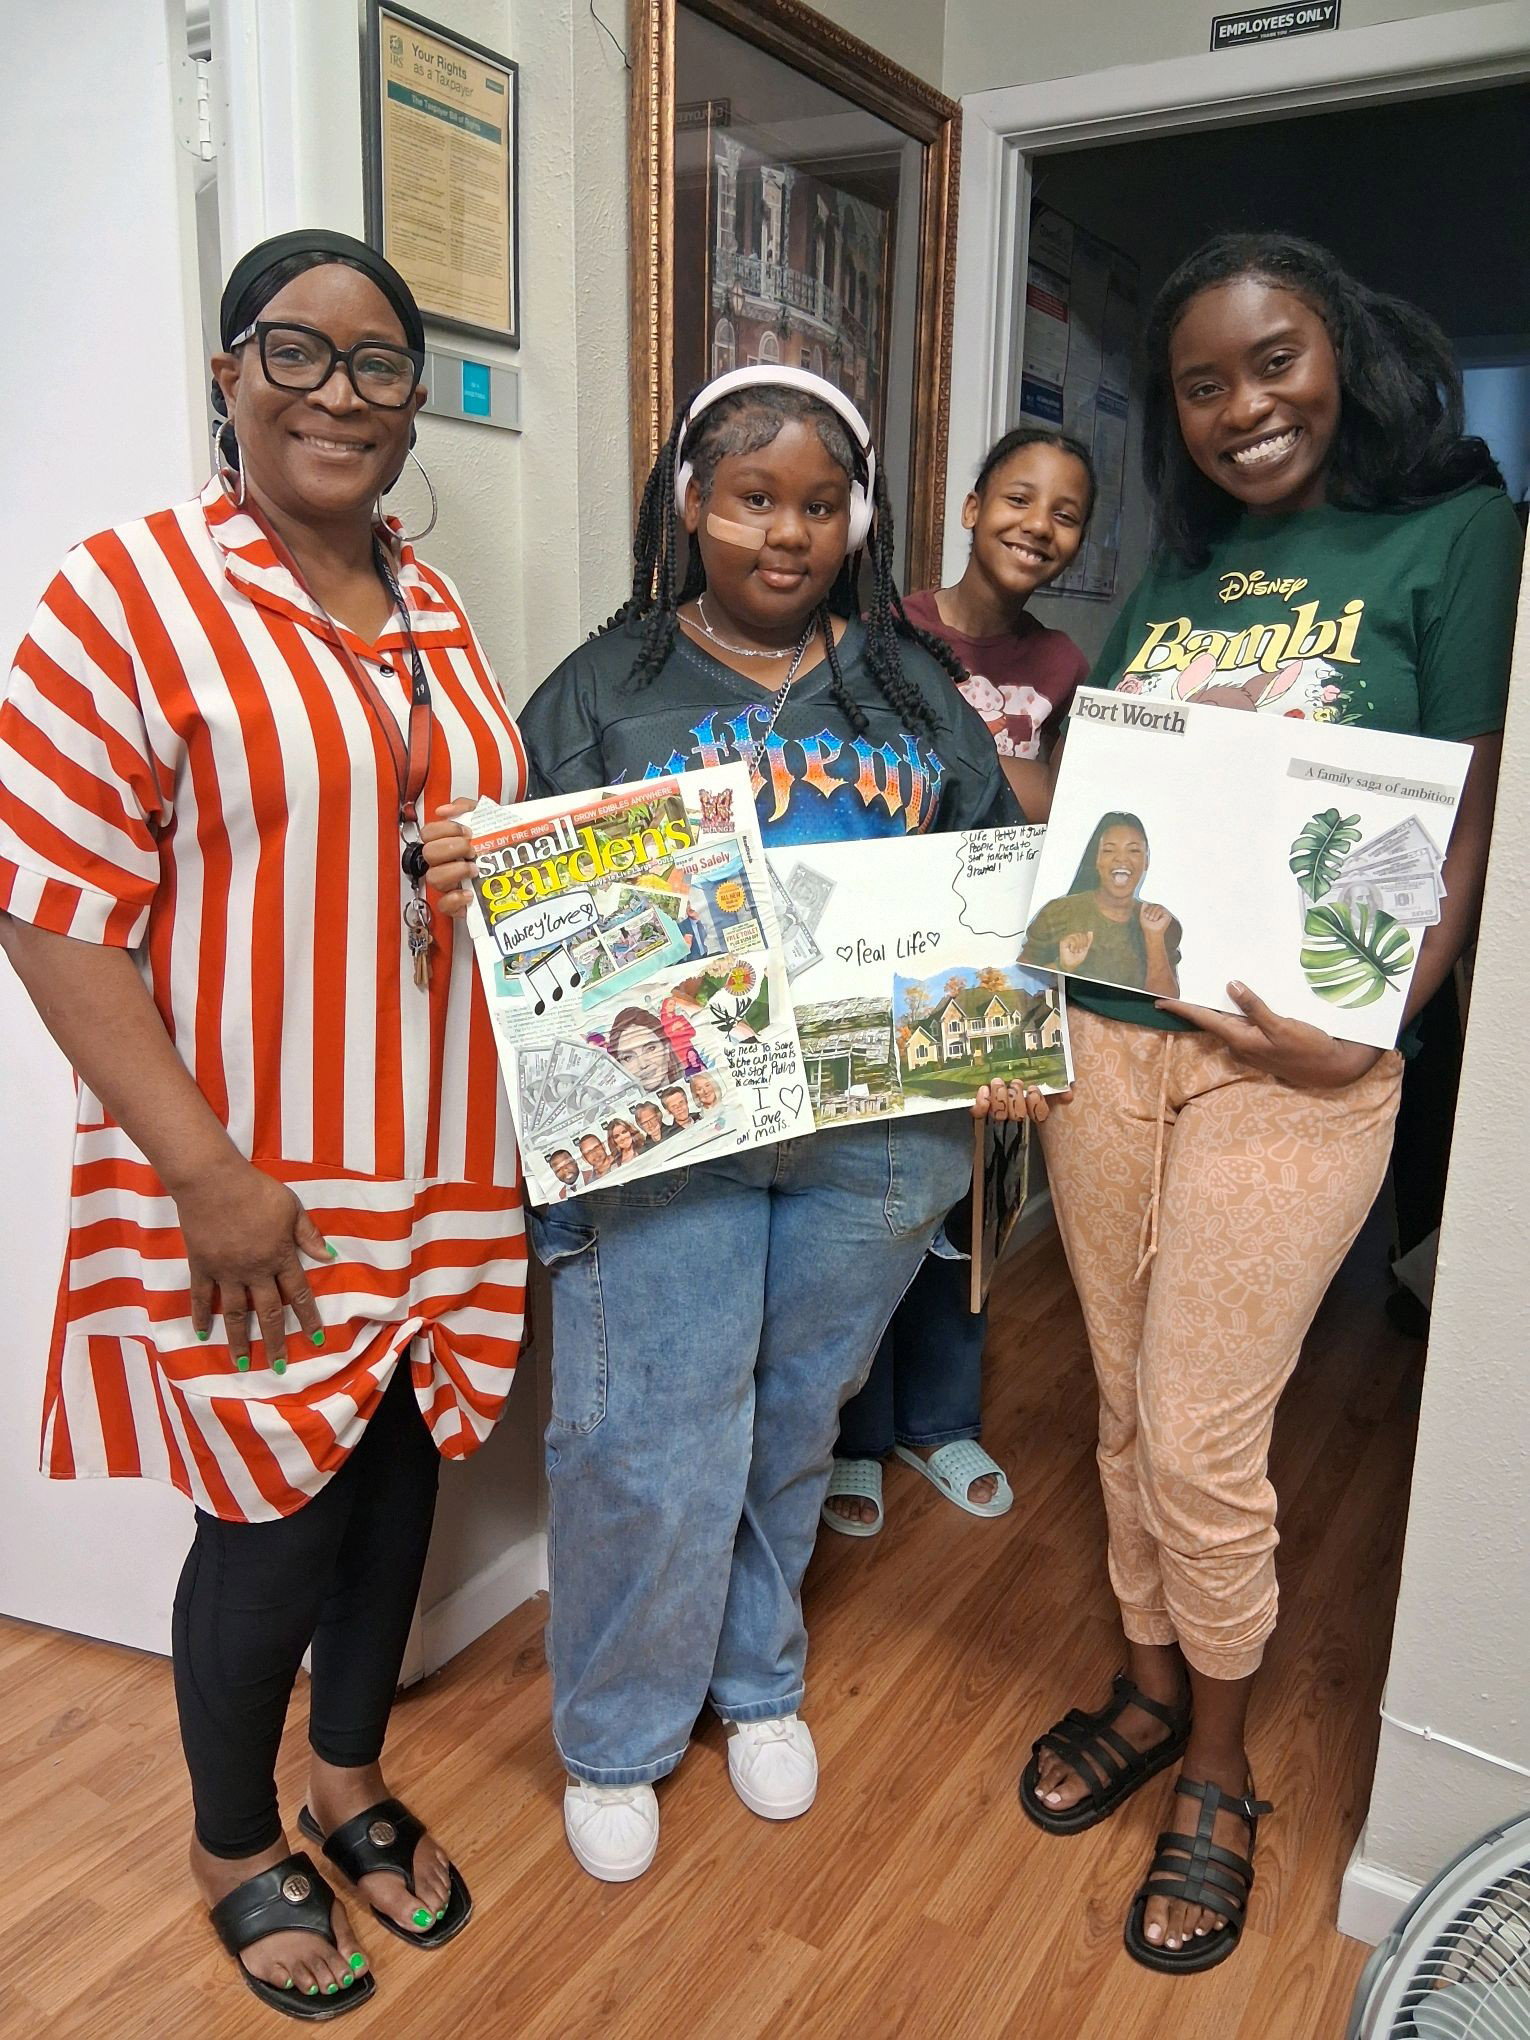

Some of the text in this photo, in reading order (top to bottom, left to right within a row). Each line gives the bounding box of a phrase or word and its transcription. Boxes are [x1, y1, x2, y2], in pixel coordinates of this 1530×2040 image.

[1218, 5, 1334, 38] EMPLOYEES ONLY
[411, 42, 467, 80] Your Rights
[413, 63, 424, 76] as
[427, 69, 433, 80] a
[434, 69, 474, 97] Taxpayer
[1218, 570, 1309, 603] Disney
[1122, 599, 1365, 677] Bambi
[1076, 696, 1186, 734] Fort Worth
[1305, 767, 1456, 806] A family saga of ambition
[573, 786, 673, 823] GROW EDIBLES ANYWHERE
[473, 824, 549, 851] EASY DIY FIRE RING
[475, 815, 583, 879] small
[998, 841, 1020, 852] need
[1020, 840, 1031, 848] to
[480, 818, 692, 925] gardens
[700, 851, 730, 868] Safely
[856, 938, 886, 967] real
[736, 1056, 751, 1068] the
[738, 1043, 758, 1057] need
[731, 1067, 746, 1078] and
[752, 1086, 771, 1112] I
[752, 1110, 782, 1128] Love
